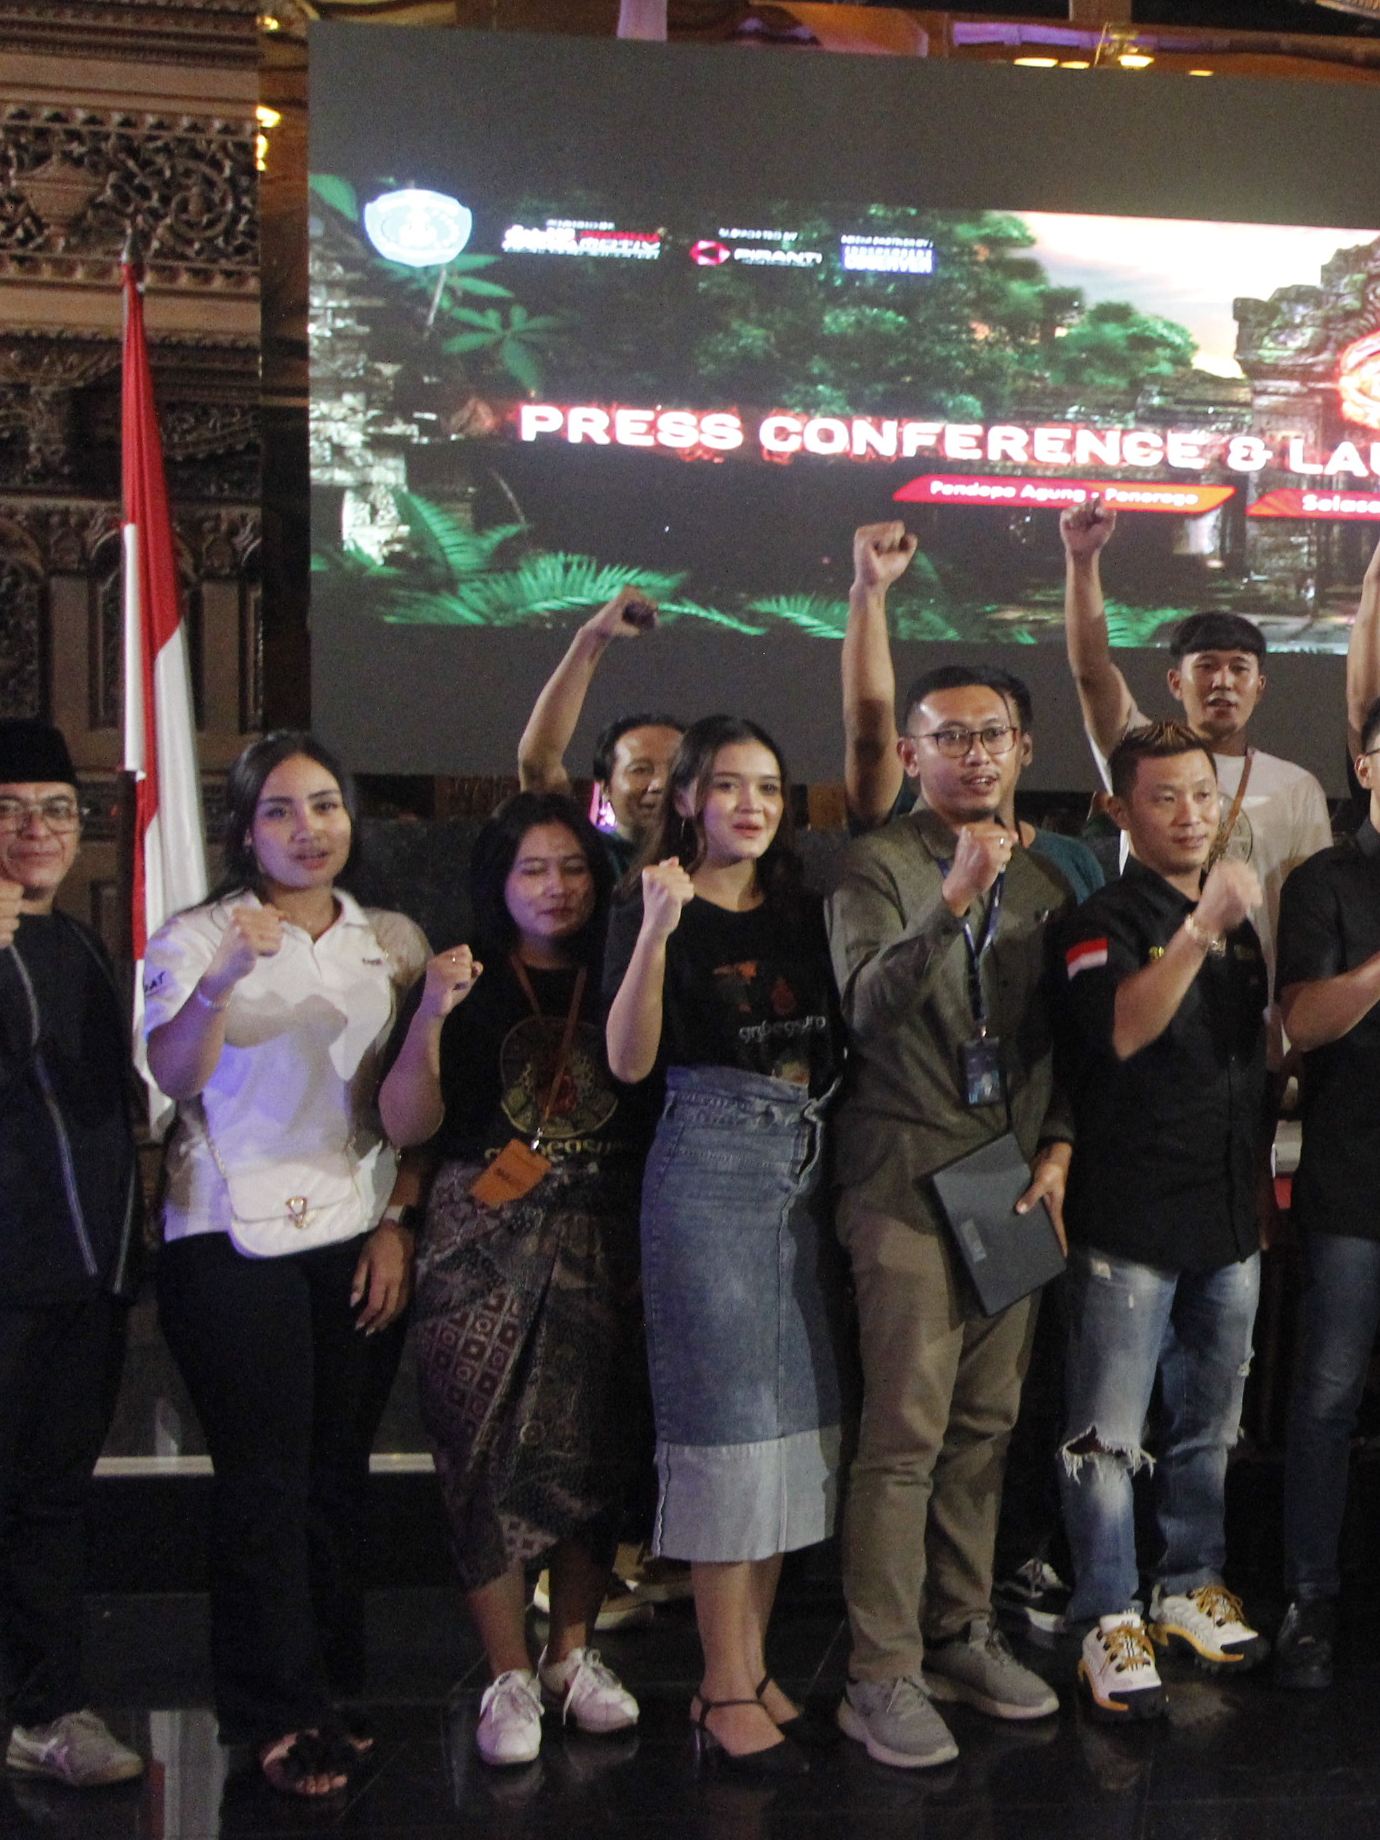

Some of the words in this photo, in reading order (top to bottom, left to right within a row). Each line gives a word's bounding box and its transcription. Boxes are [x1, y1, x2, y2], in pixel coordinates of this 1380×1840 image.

[520, 404, 744, 450] PRESS
[759, 415, 1206, 470] CONFERENCE
[1227, 436, 1273, 472] &
[1021, 484, 1086, 503] Agung
